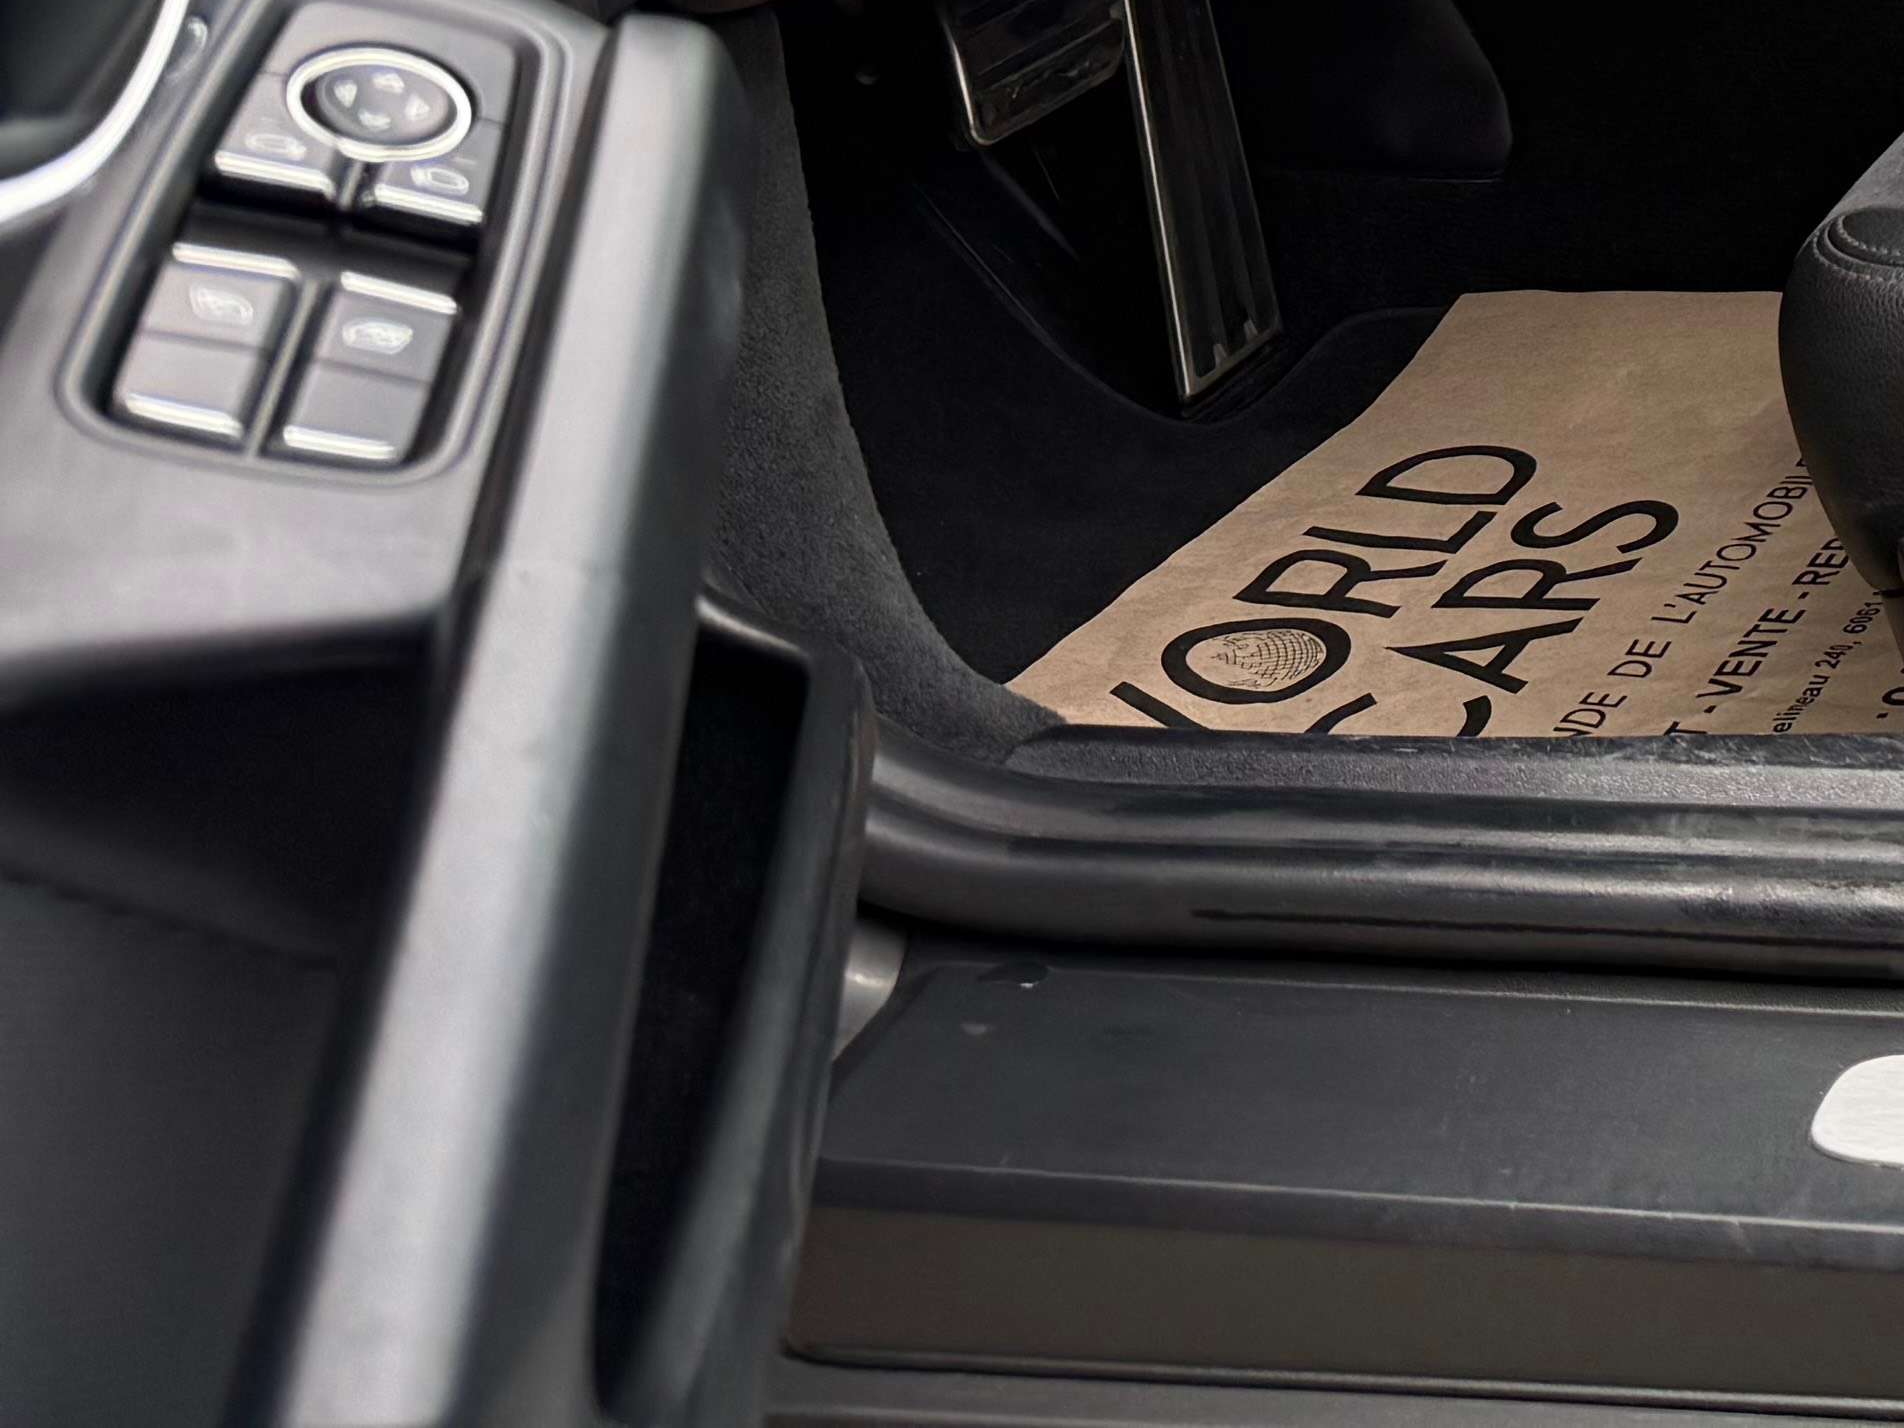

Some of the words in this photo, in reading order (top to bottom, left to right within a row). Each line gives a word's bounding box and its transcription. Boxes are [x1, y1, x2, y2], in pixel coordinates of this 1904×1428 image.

[1110, 445, 1538, 732] ORLD
[1607, 638, 1672, 679] DE
[1651, 458, 1813, 625] L'AUTOMOBIL
[1696, 607, 1807, 699] VENTE
